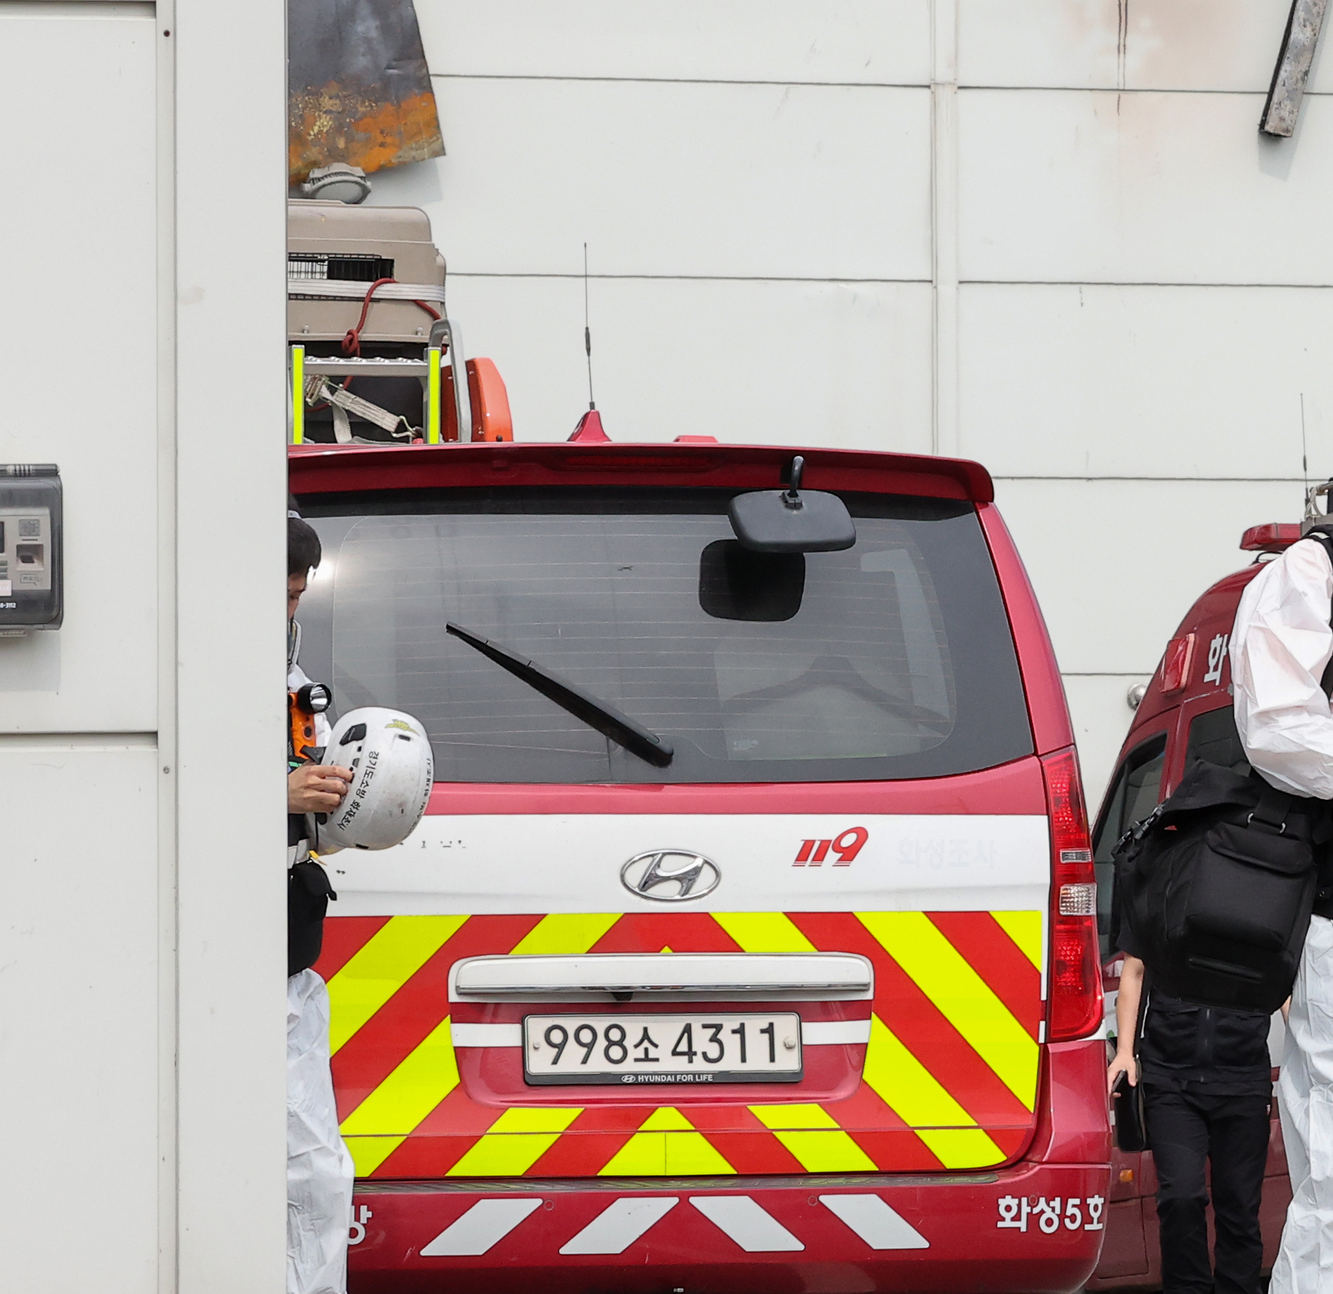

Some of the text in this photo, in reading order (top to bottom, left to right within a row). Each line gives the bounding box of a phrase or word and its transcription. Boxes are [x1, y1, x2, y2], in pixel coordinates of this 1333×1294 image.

[337, 750, 380, 831] 경기도소방 화재조사
[792, 826, 869, 867] 119
[544, 1022, 777, 1066] 998소 4311
[638, 1073, 713, 1083] HYUNDAI FOR LIFE
[997, 1195, 1105, 1234] 화성5호
